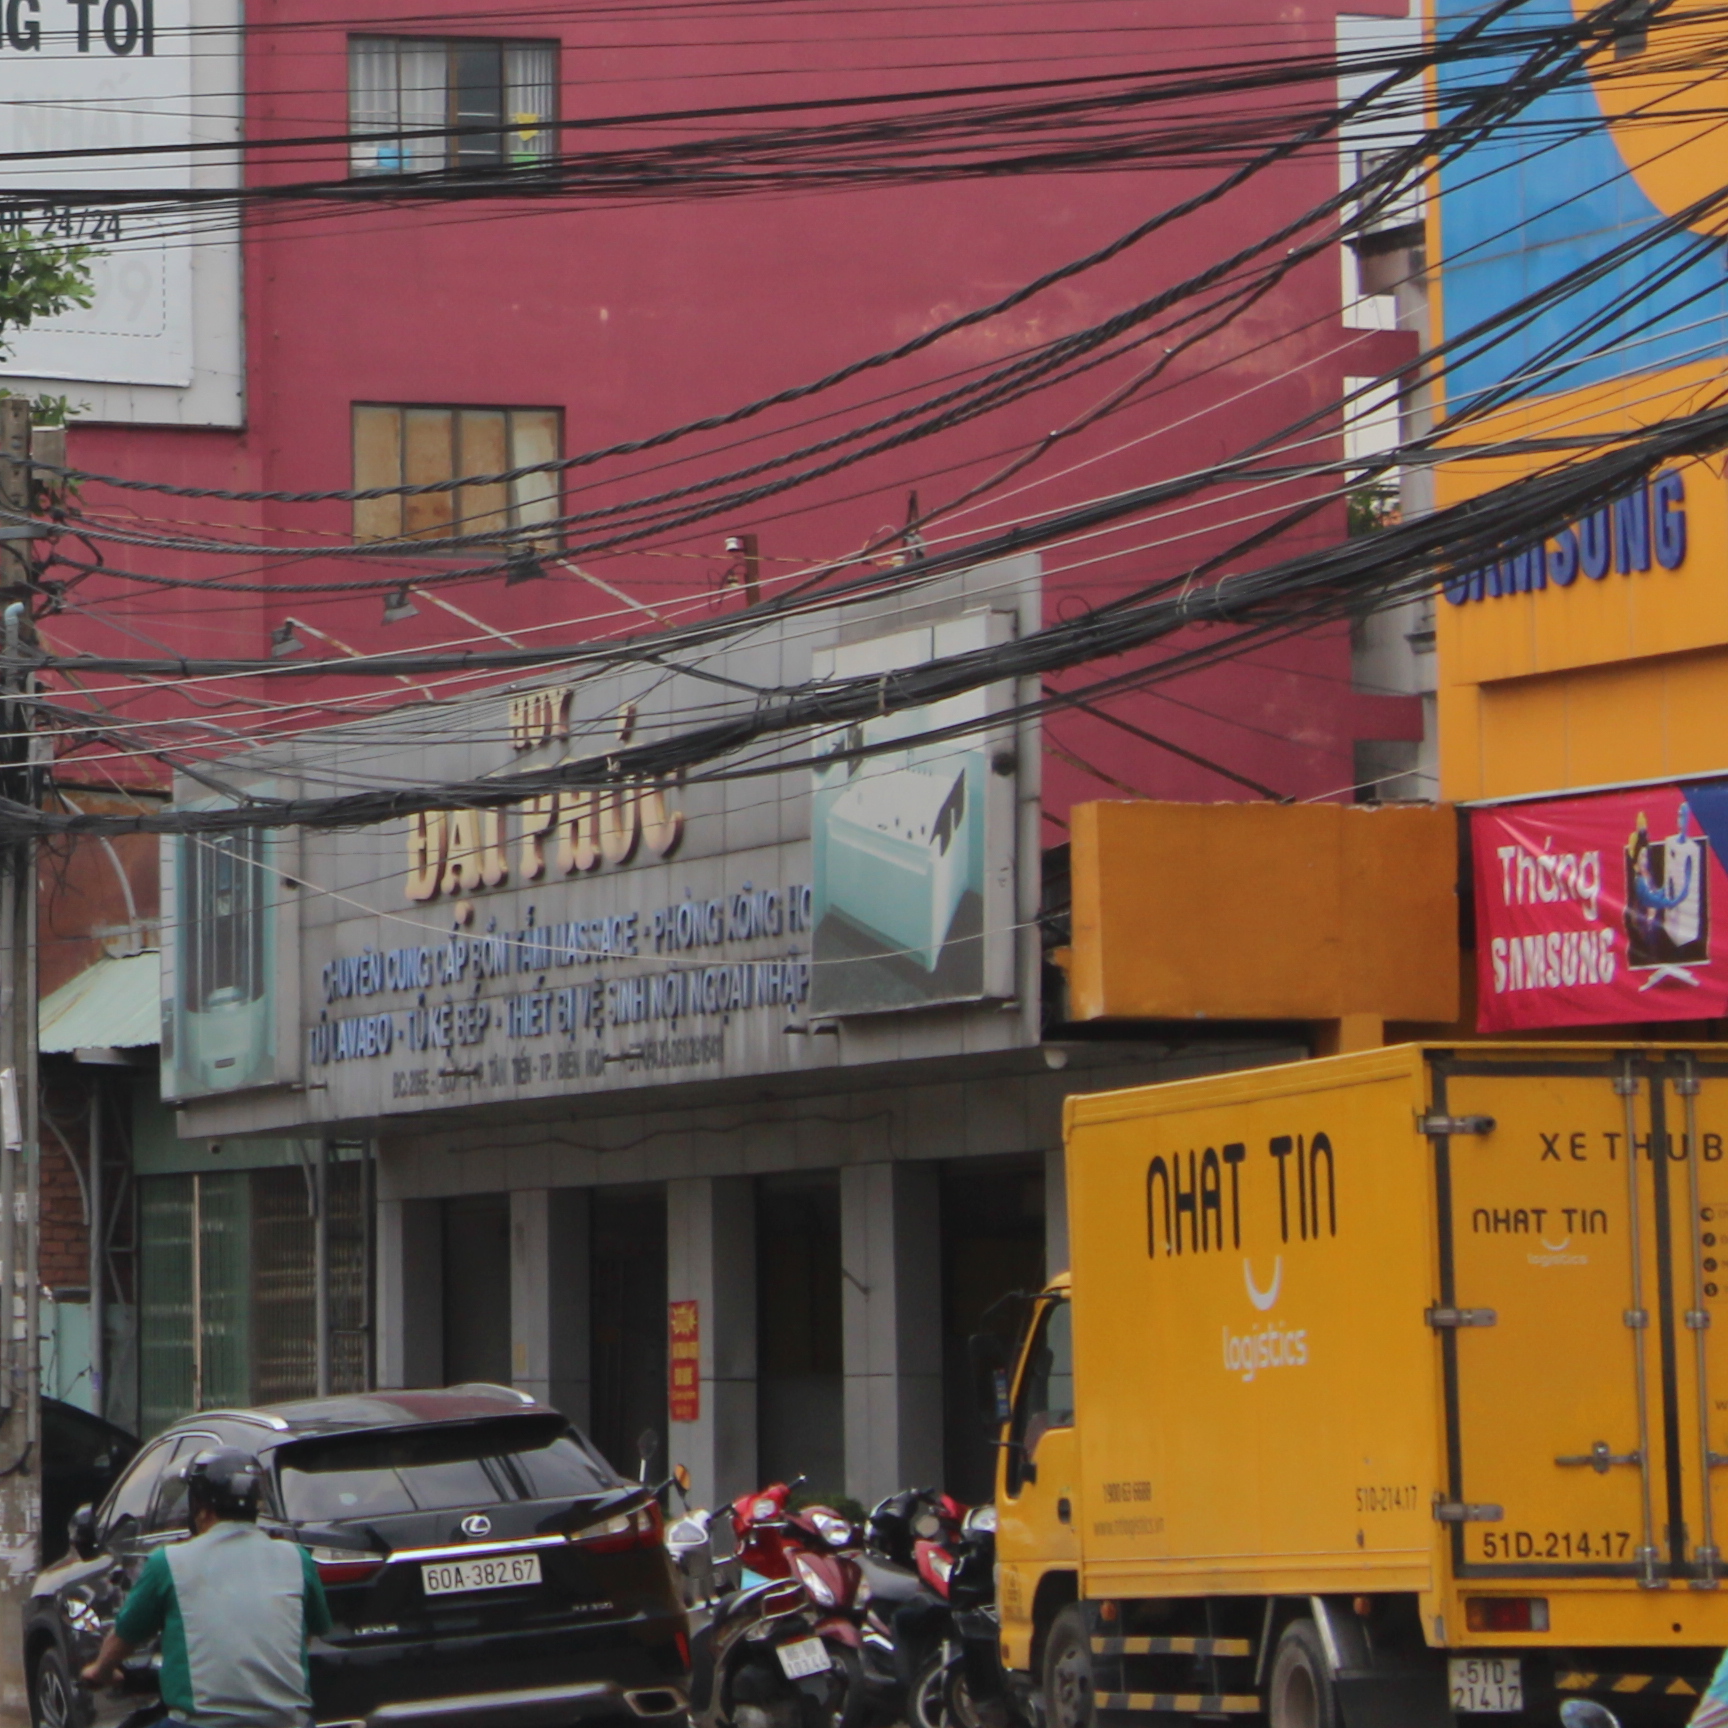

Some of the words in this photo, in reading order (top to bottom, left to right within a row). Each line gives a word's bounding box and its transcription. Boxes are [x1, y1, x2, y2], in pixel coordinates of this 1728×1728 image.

[554, 910, 639, 969] MASSAGE
[653, 886, 725, 955] PHÒNG
[332, 1013, 393, 1062] LAVABO
[1147, 1142, 1248, 1260] NHAT
[1267, 1130, 1337, 1245] TIN
[1472, 1208, 1548, 1234] NHAT
[1561, 1208, 1609, 1235] TIN
[1222, 1325, 1308, 1382] logistics
[427, 1558, 536, 1592] 60A-382.67
[1465, 1660, 1505, 1685] 51D
